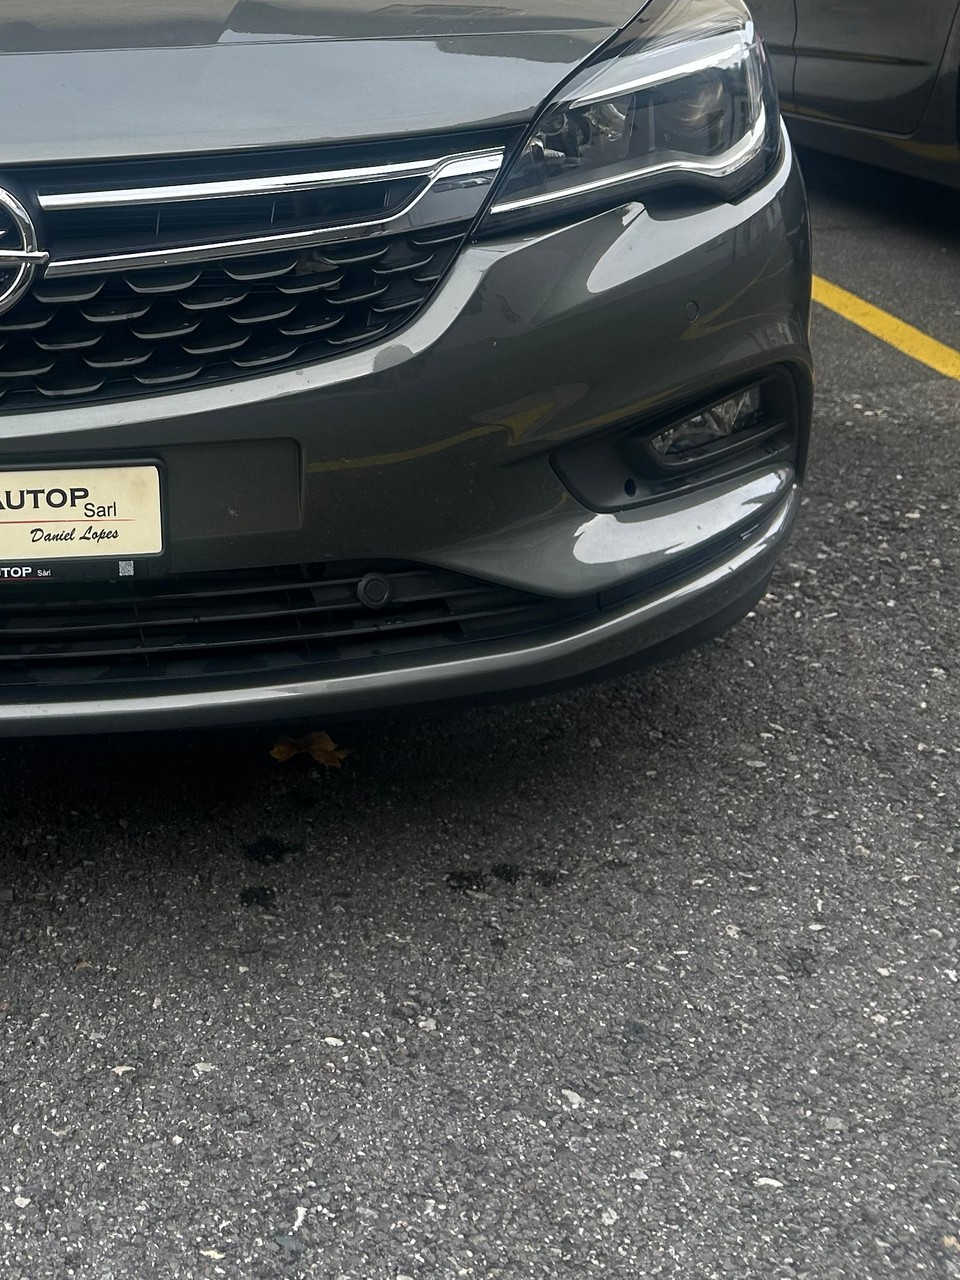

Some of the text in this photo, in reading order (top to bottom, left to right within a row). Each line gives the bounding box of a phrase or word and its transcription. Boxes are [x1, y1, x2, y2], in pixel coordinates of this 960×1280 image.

[84, 501, 117, 518] Sarl
[30, 525, 119, 544] Daniel Lopes
